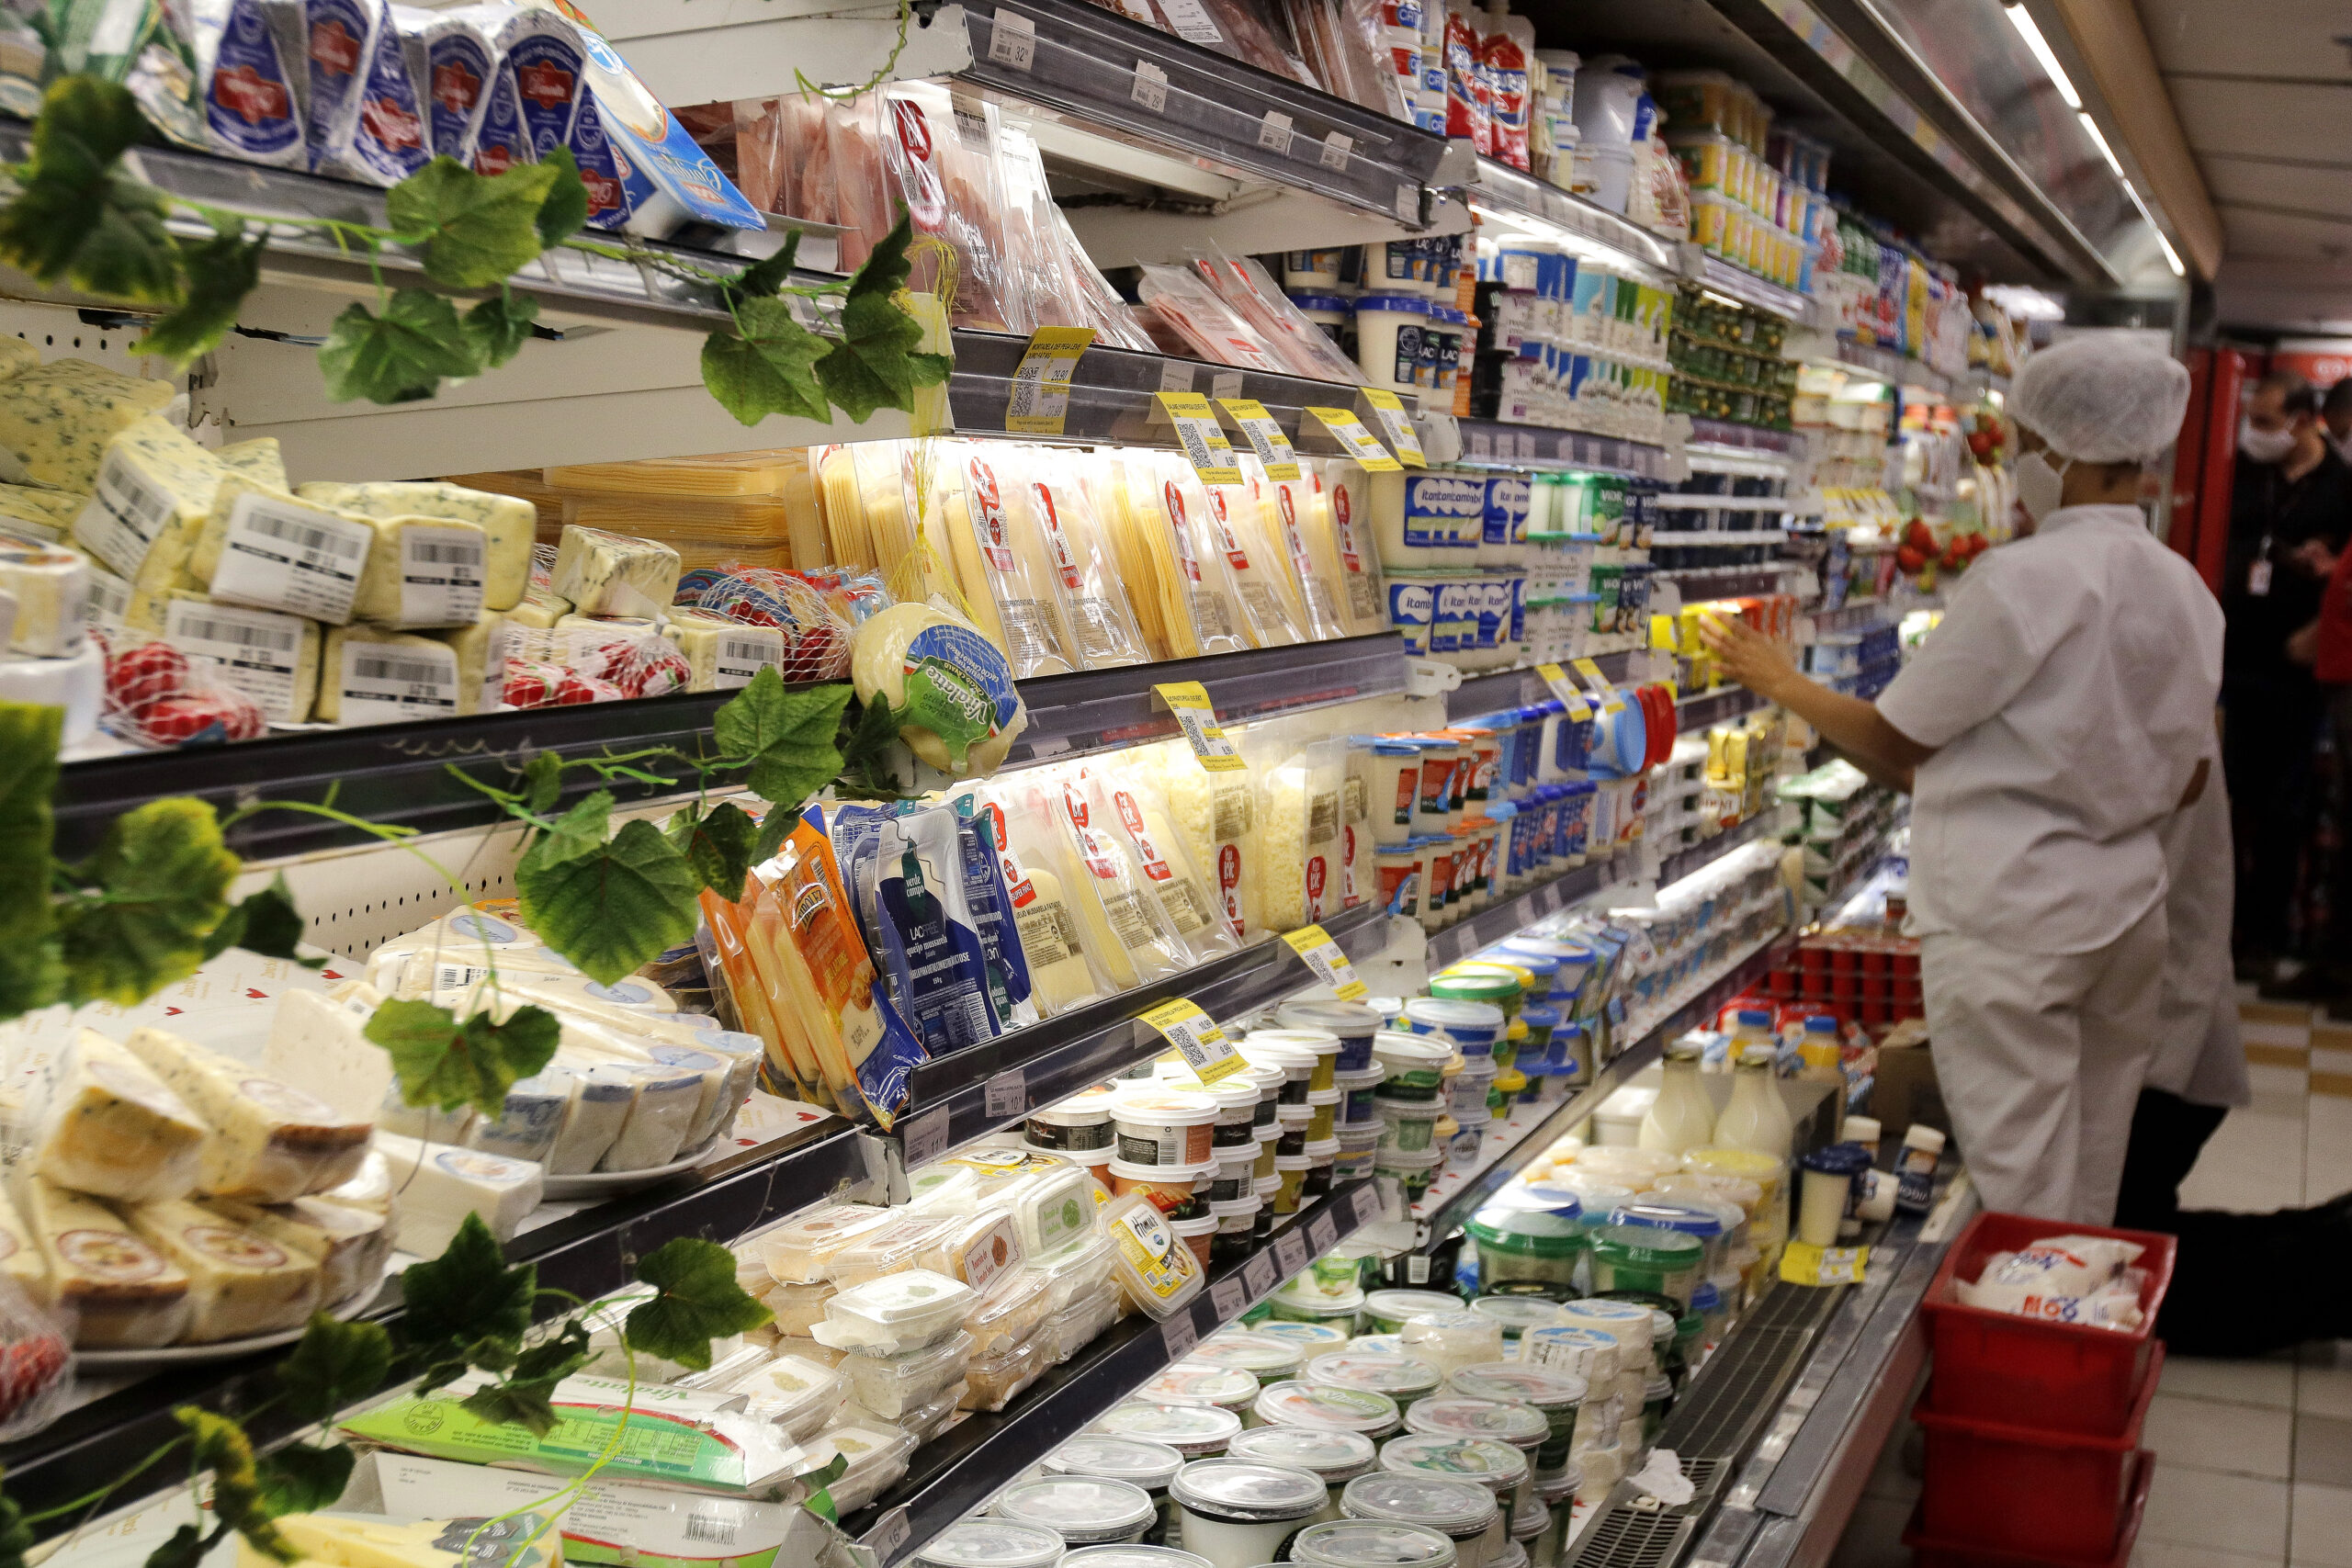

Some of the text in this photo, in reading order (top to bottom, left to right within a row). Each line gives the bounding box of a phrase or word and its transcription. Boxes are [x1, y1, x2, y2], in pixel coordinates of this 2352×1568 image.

[1441, 349, 1458, 362] LAC
[926, 666, 988, 725] Vitalatte
[906, 873, 921, 887] verde
[906, 885, 925, 899] campo
[797, 888, 824, 929] TIROLEZ
[906, 934, 948, 957] queijo mussarela
[991, 987, 1006, 998] campo
